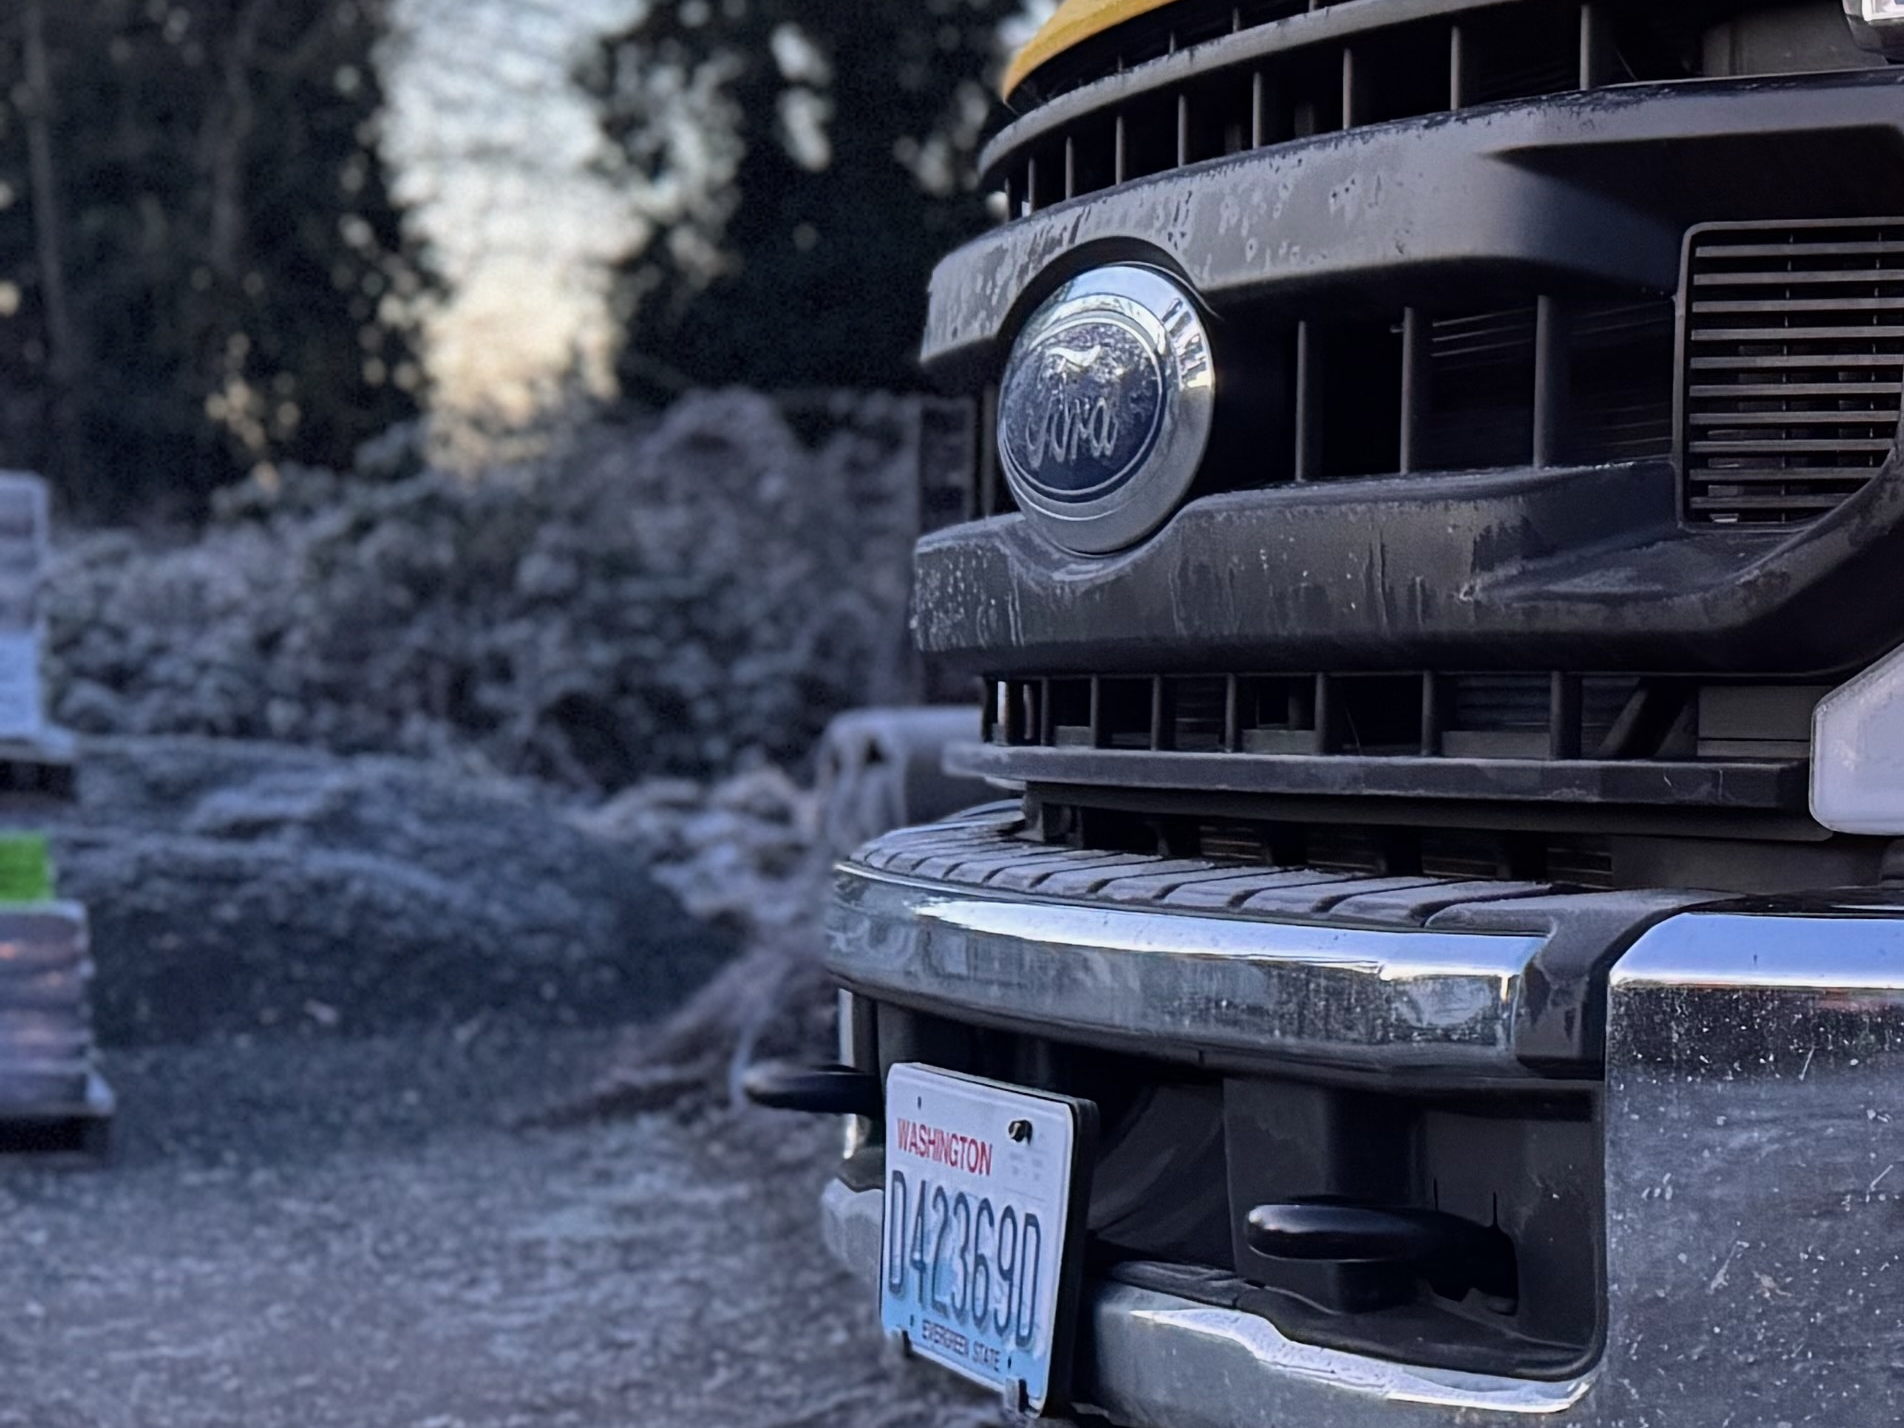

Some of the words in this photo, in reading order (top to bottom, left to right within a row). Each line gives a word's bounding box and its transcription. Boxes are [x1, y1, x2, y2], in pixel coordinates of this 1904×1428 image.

[896, 1117, 994, 1177] WASHINGTON
[888, 1169, 1042, 1349] D42369D
[972, 1340, 1001, 1373] STATE
